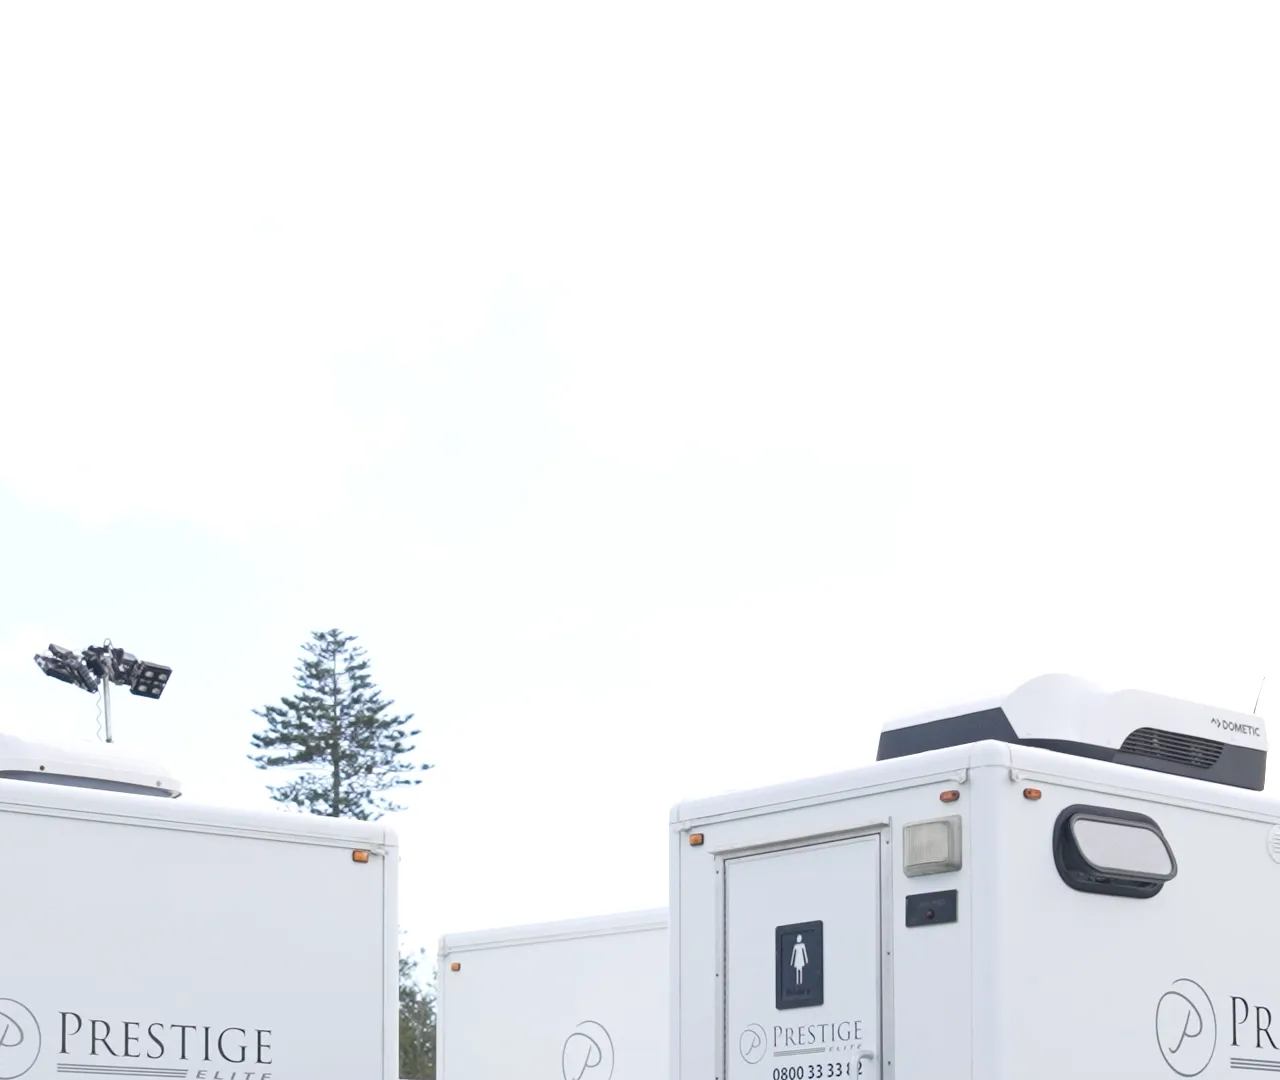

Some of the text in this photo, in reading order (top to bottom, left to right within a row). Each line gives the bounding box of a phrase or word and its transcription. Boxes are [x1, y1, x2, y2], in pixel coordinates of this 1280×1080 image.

[1222, 719, 1261, 737] DOMETIC
[57, 1010, 273, 1065] PRESTIGE
[773, 1020, 863, 1048] PRESTIGE
[829, 1044, 862, 1052] ELITE
[808, 1065, 824, 1080] 33
[827, 1062, 843, 1078] 33
